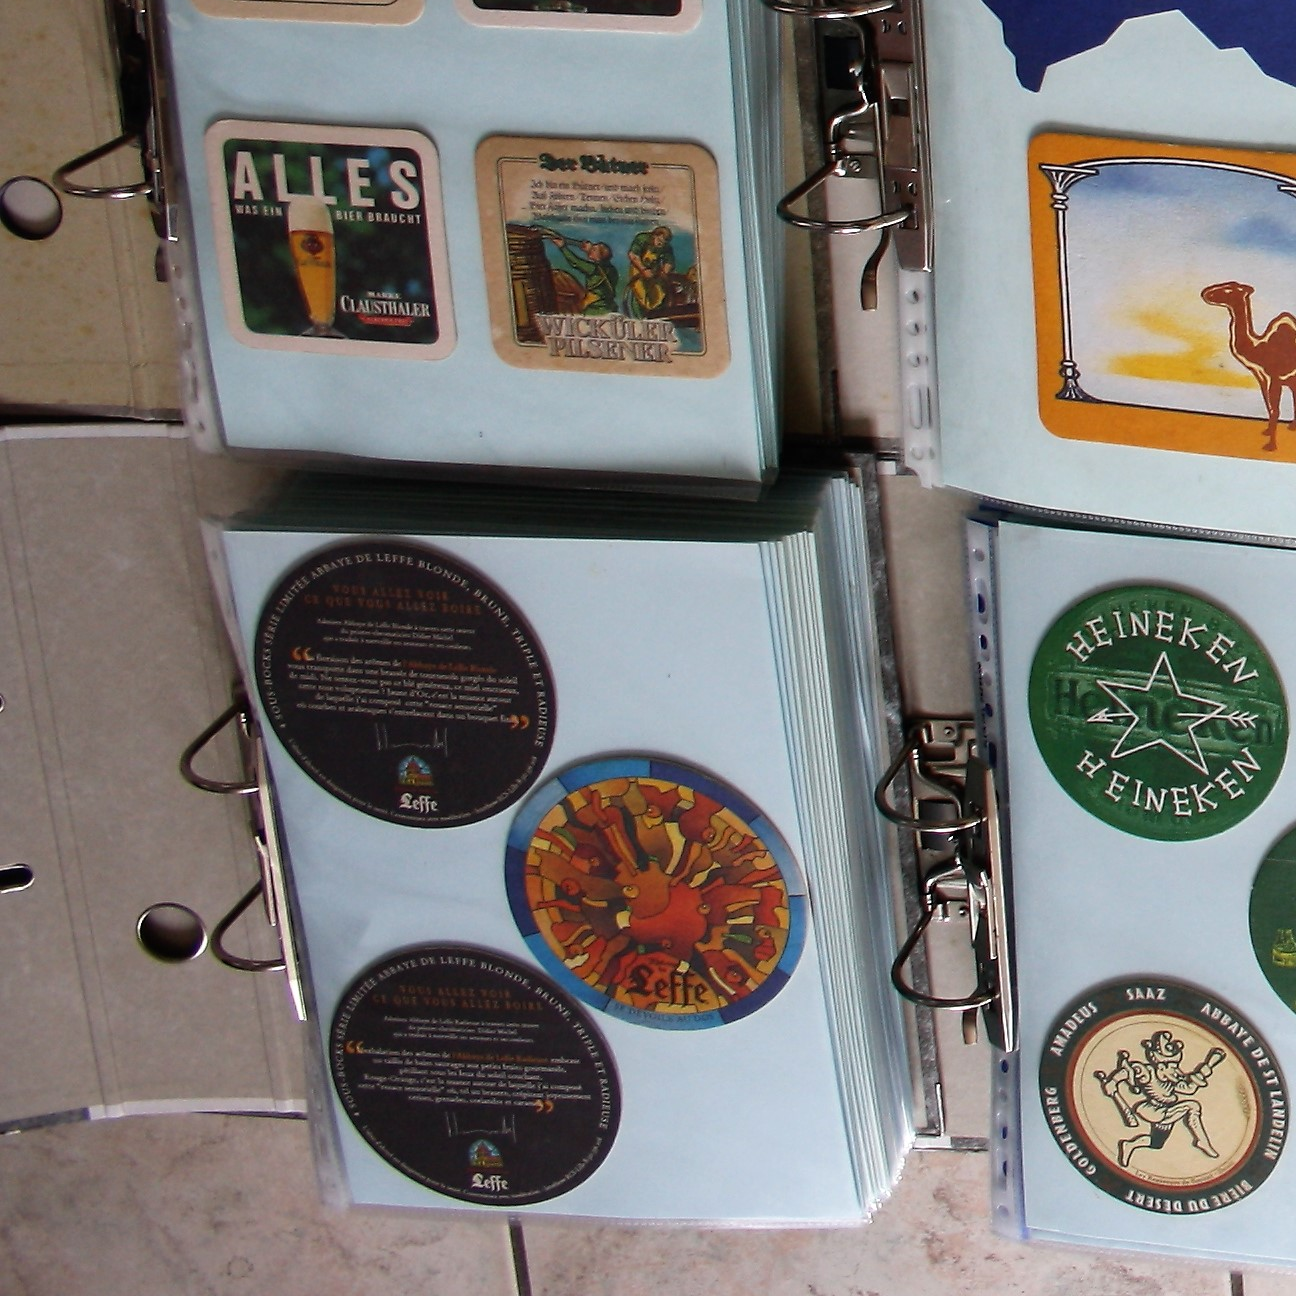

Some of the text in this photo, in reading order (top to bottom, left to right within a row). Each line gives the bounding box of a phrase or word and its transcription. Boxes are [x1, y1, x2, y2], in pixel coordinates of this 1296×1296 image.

[233, 151, 420, 210] ALLES
[340, 296, 431, 317] CLAUSTHALER
[535, 314, 678, 342] WICKÜLER
[548, 337, 672, 363] PILSENER
[1066, 610, 1259, 684] HEINEKEN
[1075, 747, 1261, 817] HEINEKEN
[626, 964, 712, 1007] Leffe
[1126, 987, 1166, 1000] SAAZ
[1050, 1002, 1099, 1057] AMADEUS
